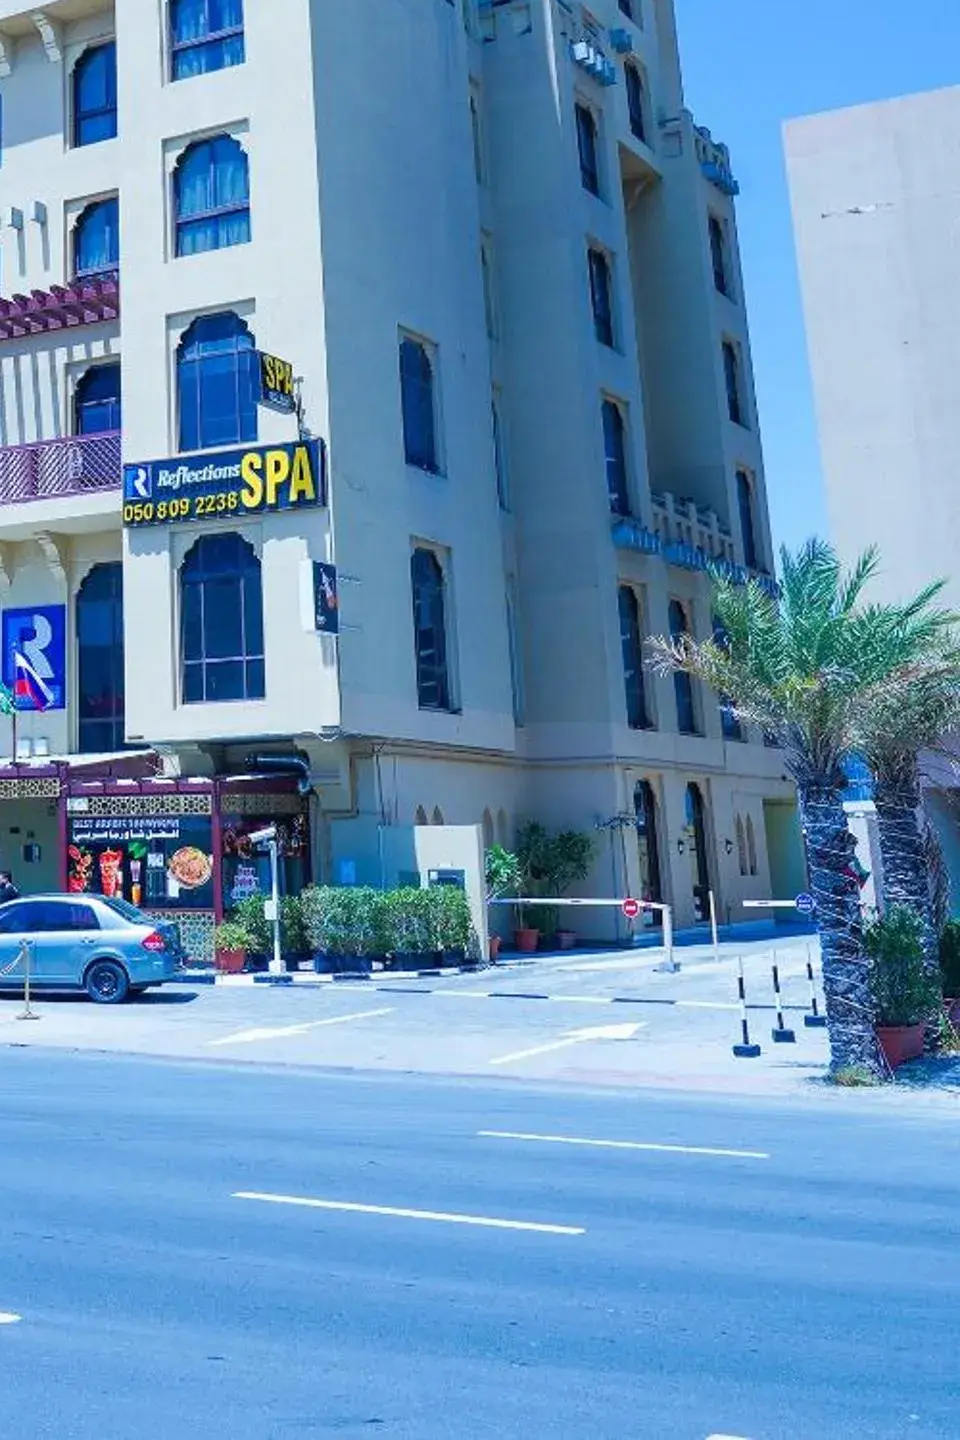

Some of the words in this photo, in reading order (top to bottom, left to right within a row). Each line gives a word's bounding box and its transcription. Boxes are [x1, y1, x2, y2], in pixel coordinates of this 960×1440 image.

[263, 354, 294, 395] SPA
[158, 463, 240, 489] Reflections
[241, 447, 315, 508] SPA
[123, 503, 153, 522] 050
[157, 498, 190, 520] 809
[195, 492, 238, 514] 2238
